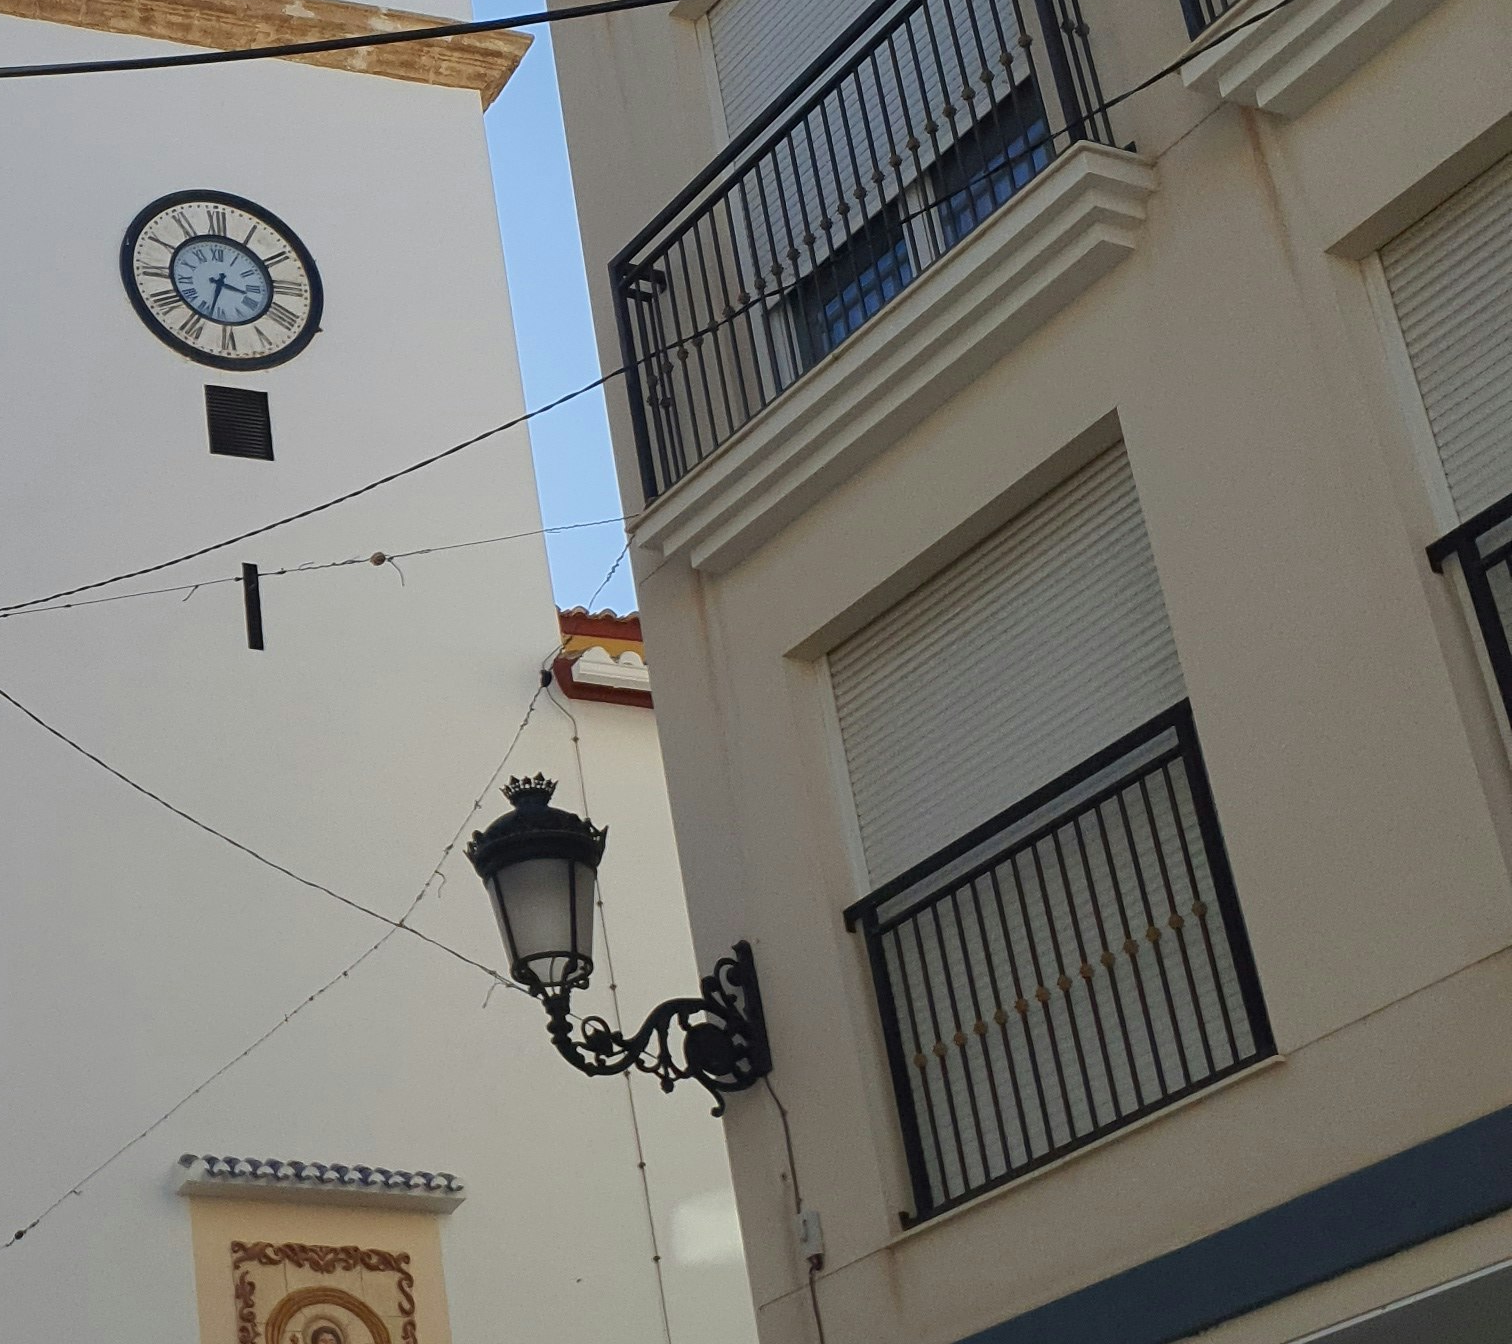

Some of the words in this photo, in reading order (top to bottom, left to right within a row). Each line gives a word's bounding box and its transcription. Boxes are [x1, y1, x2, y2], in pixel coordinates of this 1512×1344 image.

[171, 211, 198, 238] XI
[206, 210, 227, 236] XII
[148, 231, 176, 254] X
[262, 250, 290, 268] II
[271, 280, 304, 298] III
